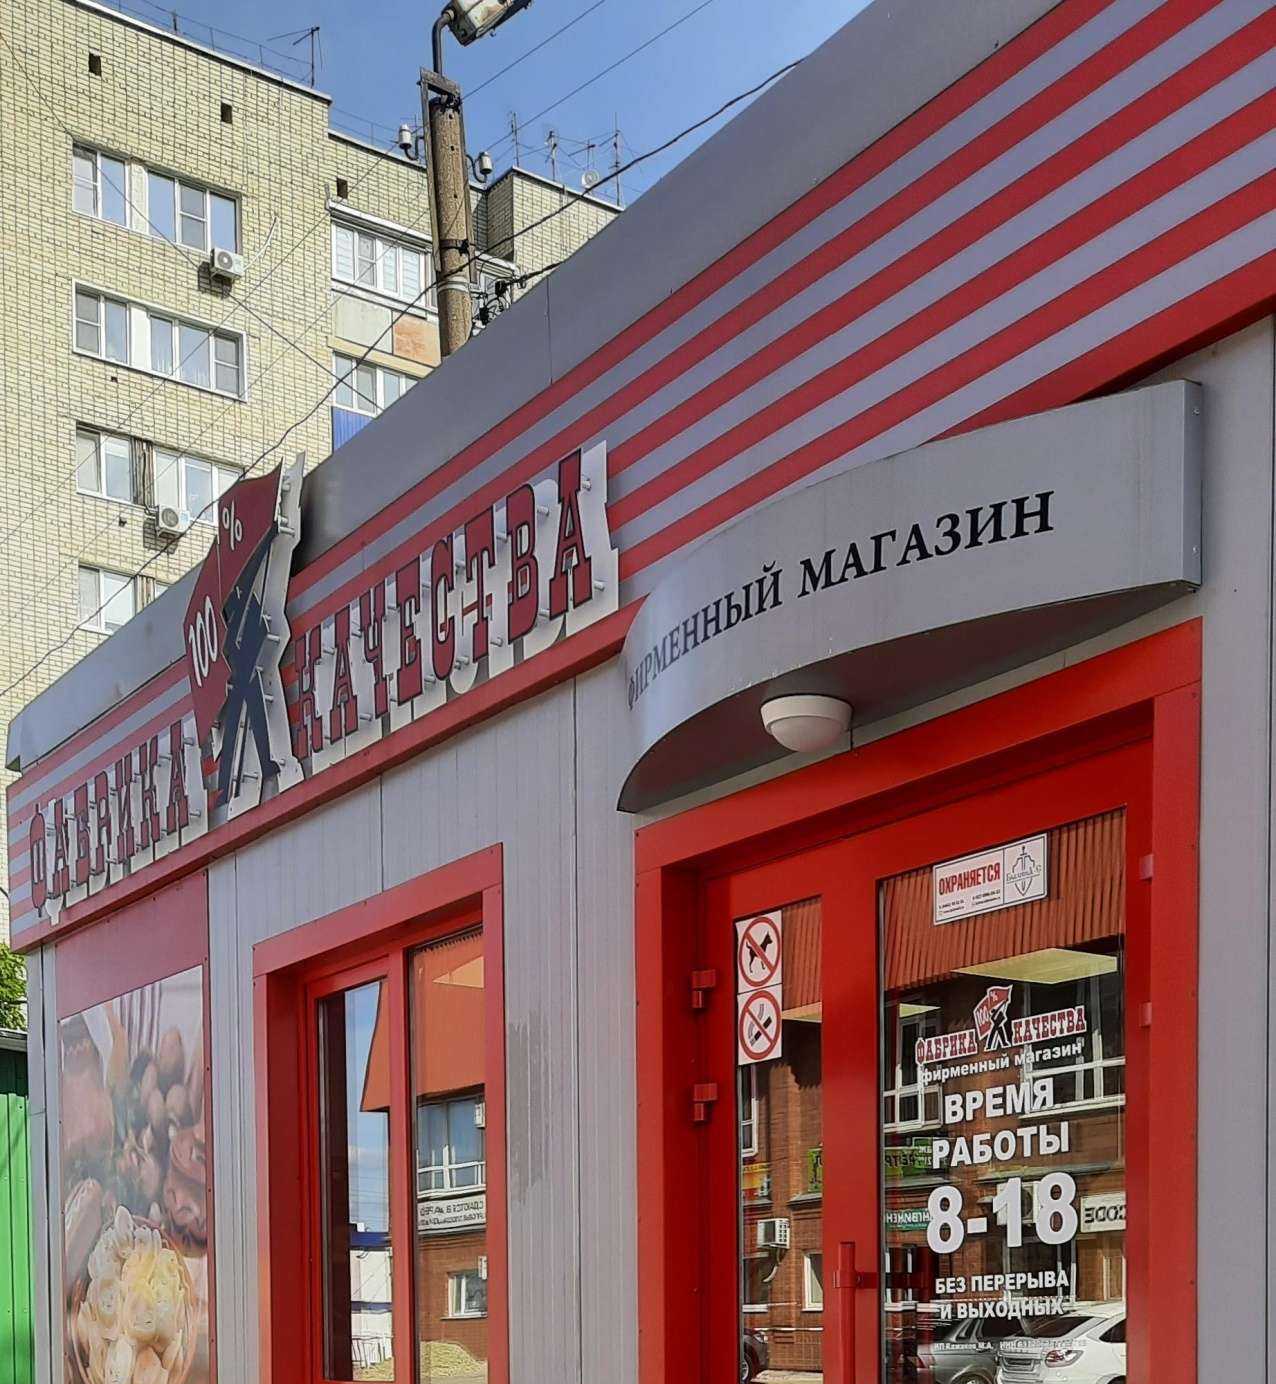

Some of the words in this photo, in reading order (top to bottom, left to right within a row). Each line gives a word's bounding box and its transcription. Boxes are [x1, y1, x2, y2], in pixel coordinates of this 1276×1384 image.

[627, 560, 784, 712] ФИРМЕННЫЙ
[796, 490, 1056, 600] МАГАЗИН
[188, 595, 219, 688] 100
[29, 718, 190, 919] ФАБРИКА
[292, 446, 594, 761] КАЧЕСТВА
[938, 862, 1001, 896] ОХРАНЯЕТСЯ
[916, 1032, 978, 1064] ФАБРИКА
[1012, 1006, 1086, 1045] КАЧЕСТВА
[923, 1054, 1010, 1087] фирменный
[1014, 1042, 1083, 1067] магазин
[943, 1077, 1055, 1125] ВРЕМЯ
[932, 1121, 1070, 1170] РАБОТЫ
[926, 1171, 1078, 1255] 8-18
[935, 1276, 966, 1294] БЕЗ
[971, 1270, 1069, 1292] ПЕРЕРЫВА
[940, 1304, 952, 1320] И
[957, 1297, 1064, 1321] ВЫХОДНЫХ
